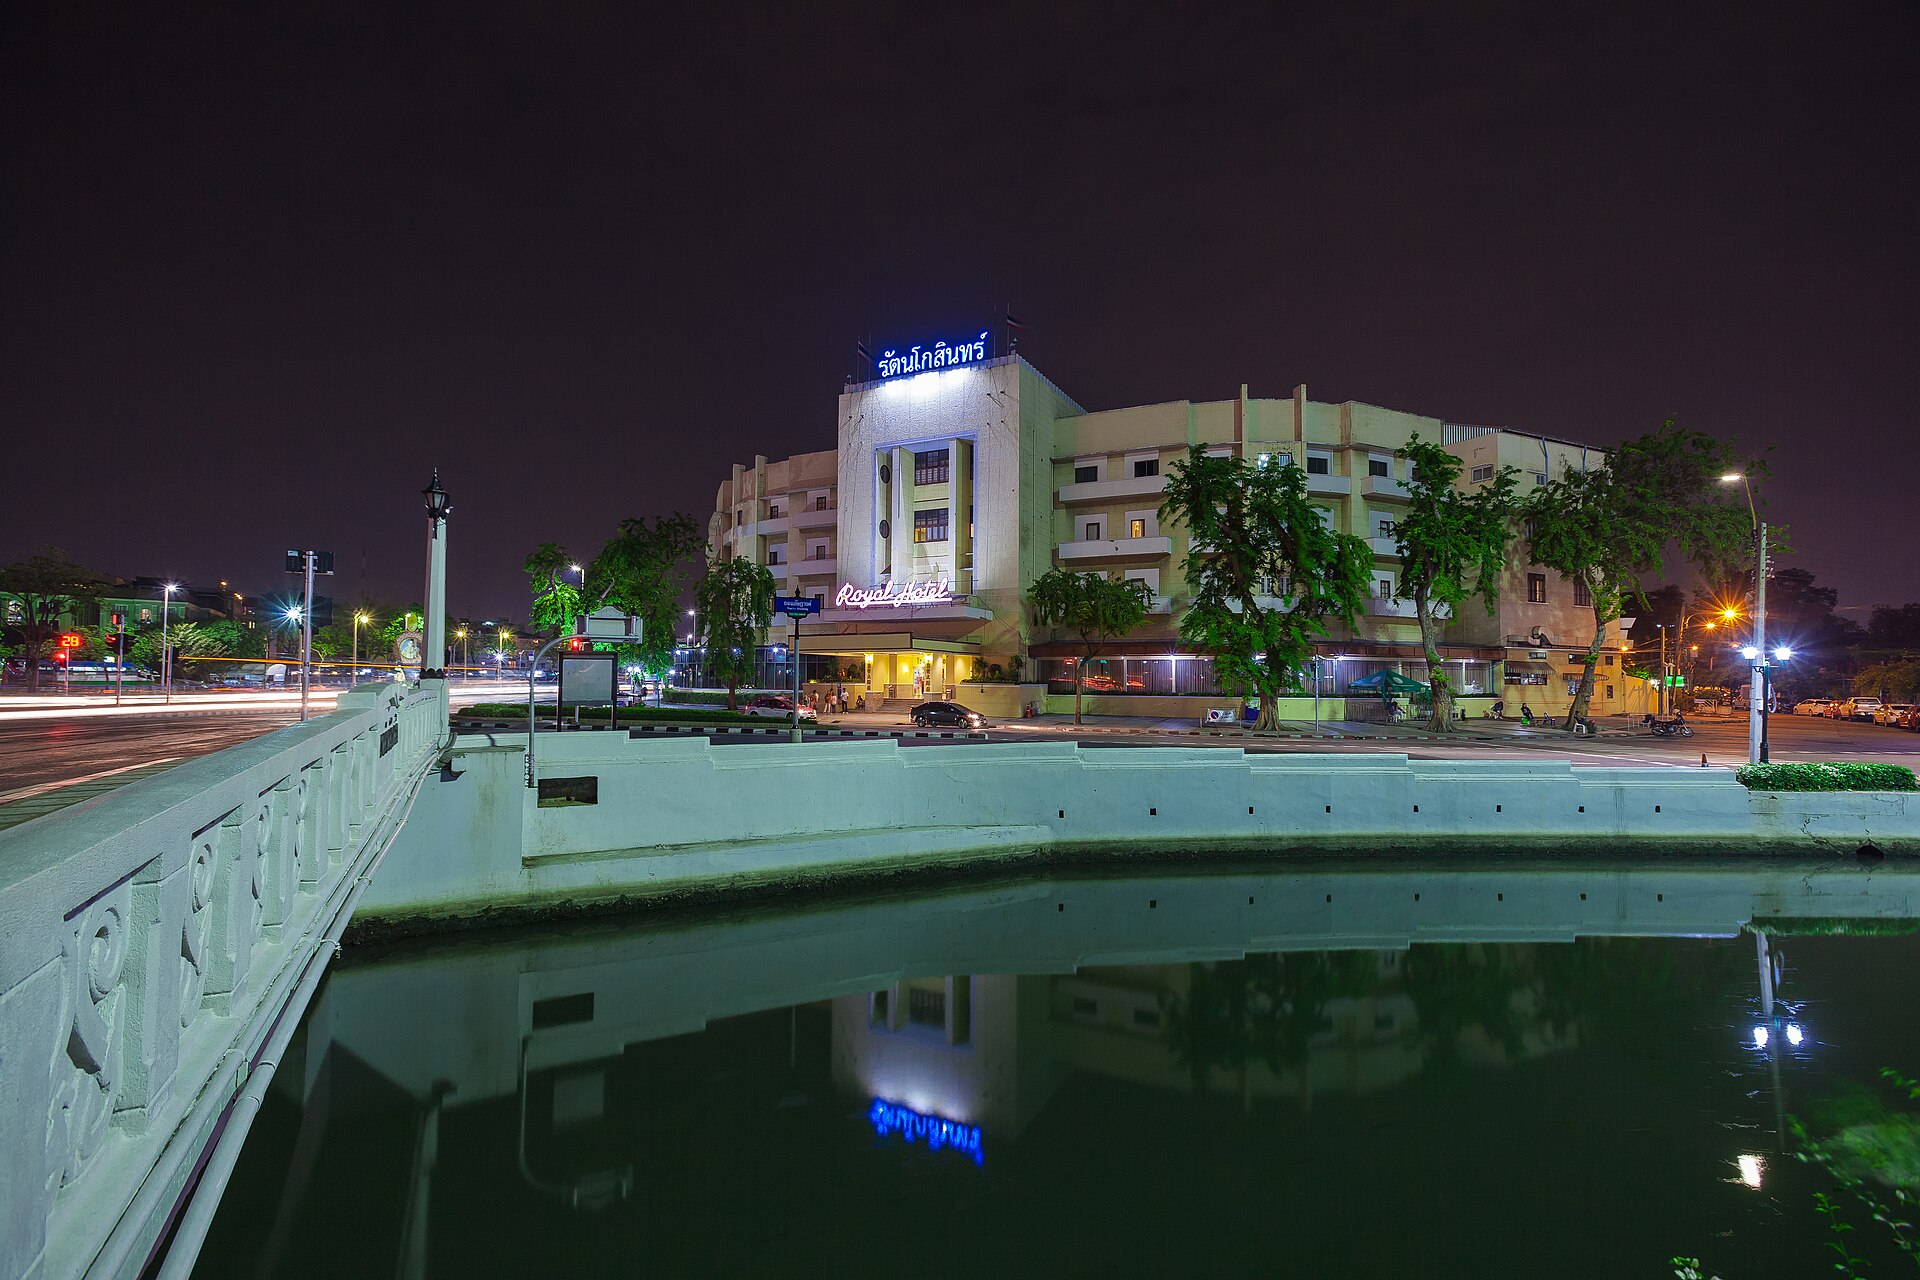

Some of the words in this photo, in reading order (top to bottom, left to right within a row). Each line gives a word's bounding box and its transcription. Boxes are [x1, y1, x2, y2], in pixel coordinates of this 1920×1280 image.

[878, 331, 988, 377] รัตนโกสินทร์
[836, 580, 894, 608] Royal
[893, 577, 951, 607] Hotel
[62, 635, 79, 646] 28
